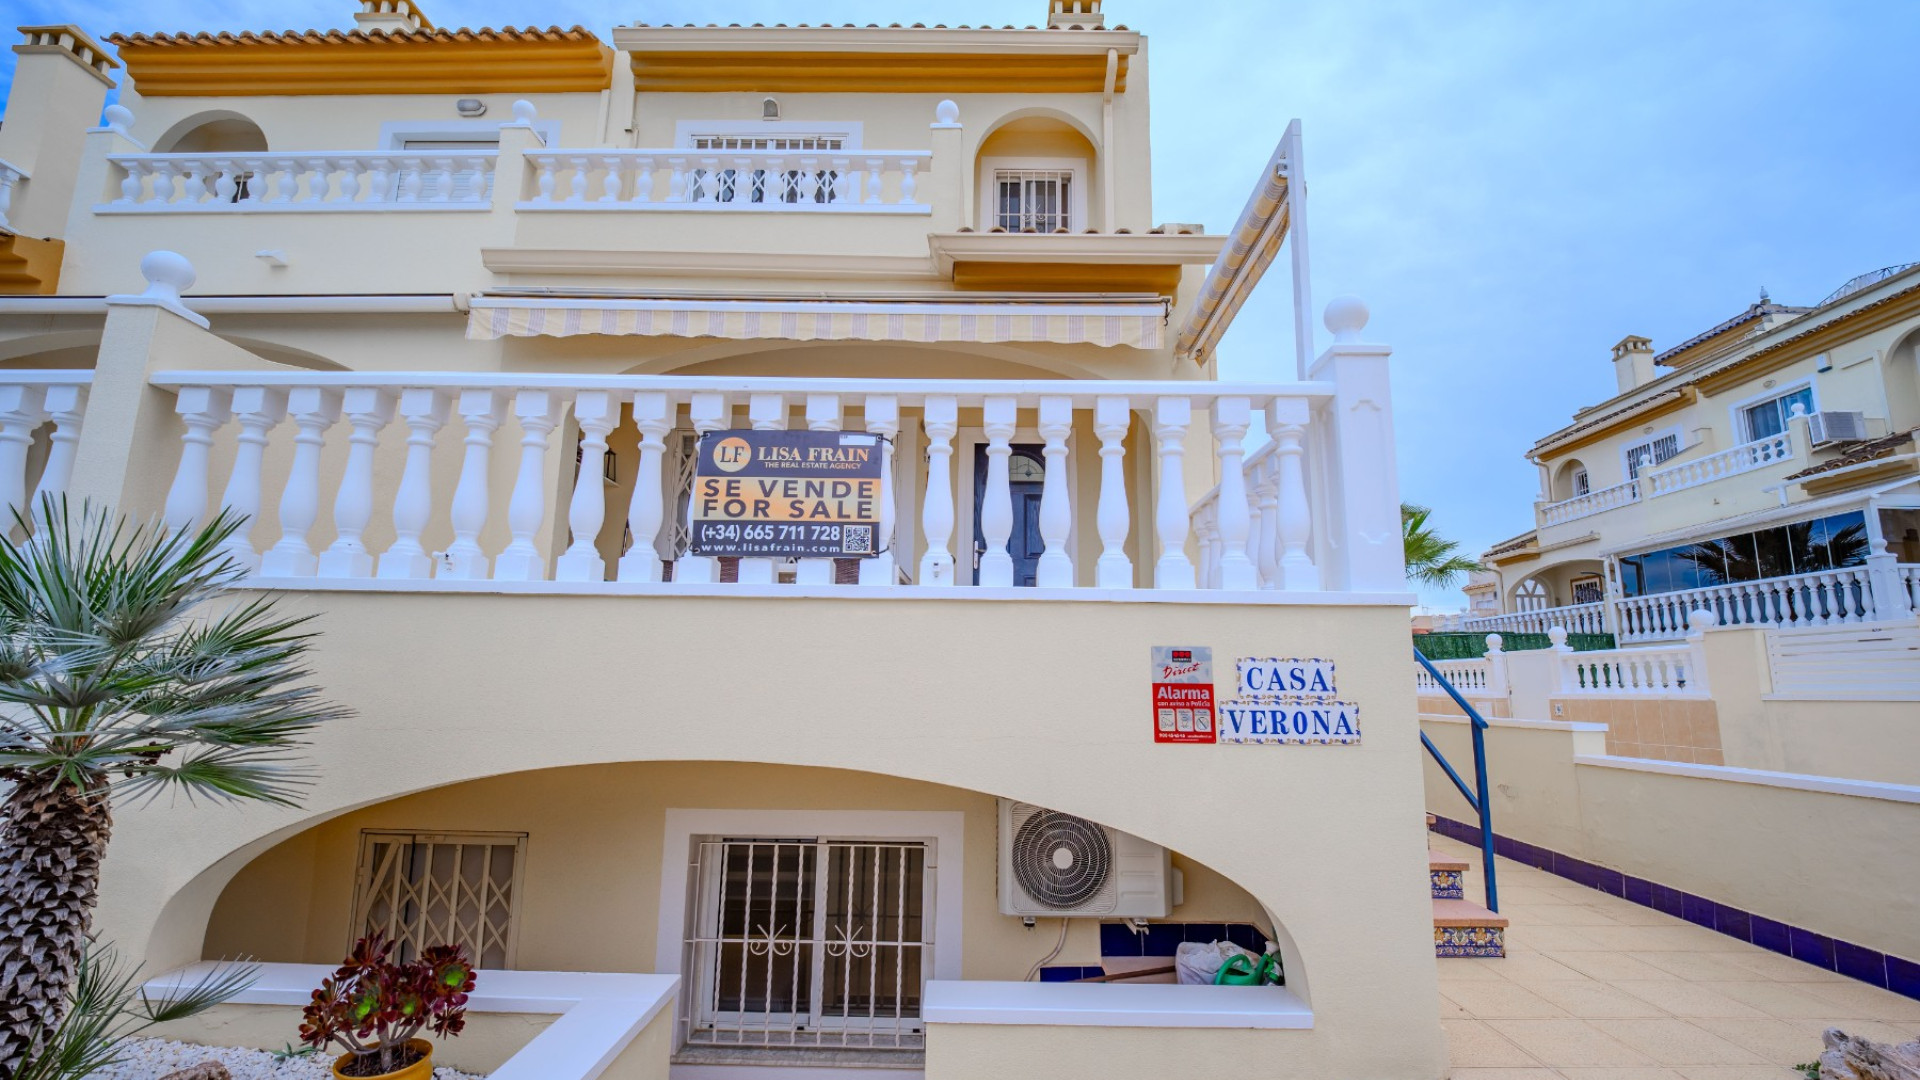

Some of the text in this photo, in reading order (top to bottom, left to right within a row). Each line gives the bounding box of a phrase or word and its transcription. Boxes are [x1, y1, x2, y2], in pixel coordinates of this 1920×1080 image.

[720, 446, 744, 463] LF
[757, 447, 870, 462] LISA FRAIN
[704, 479, 872, 499] SE VENDE
[703, 499, 872, 519] FOR SALE
[701, 525, 840, 541] (+34) 665 711 728
[701, 543, 840, 553] www.lisafrain.com
[1163, 662, 1200, 679] Direct
[1247, 667, 1330, 691] CASA
[1158, 686, 1210, 699] Alarma
[1227, 710, 1354, 735] VERONA
